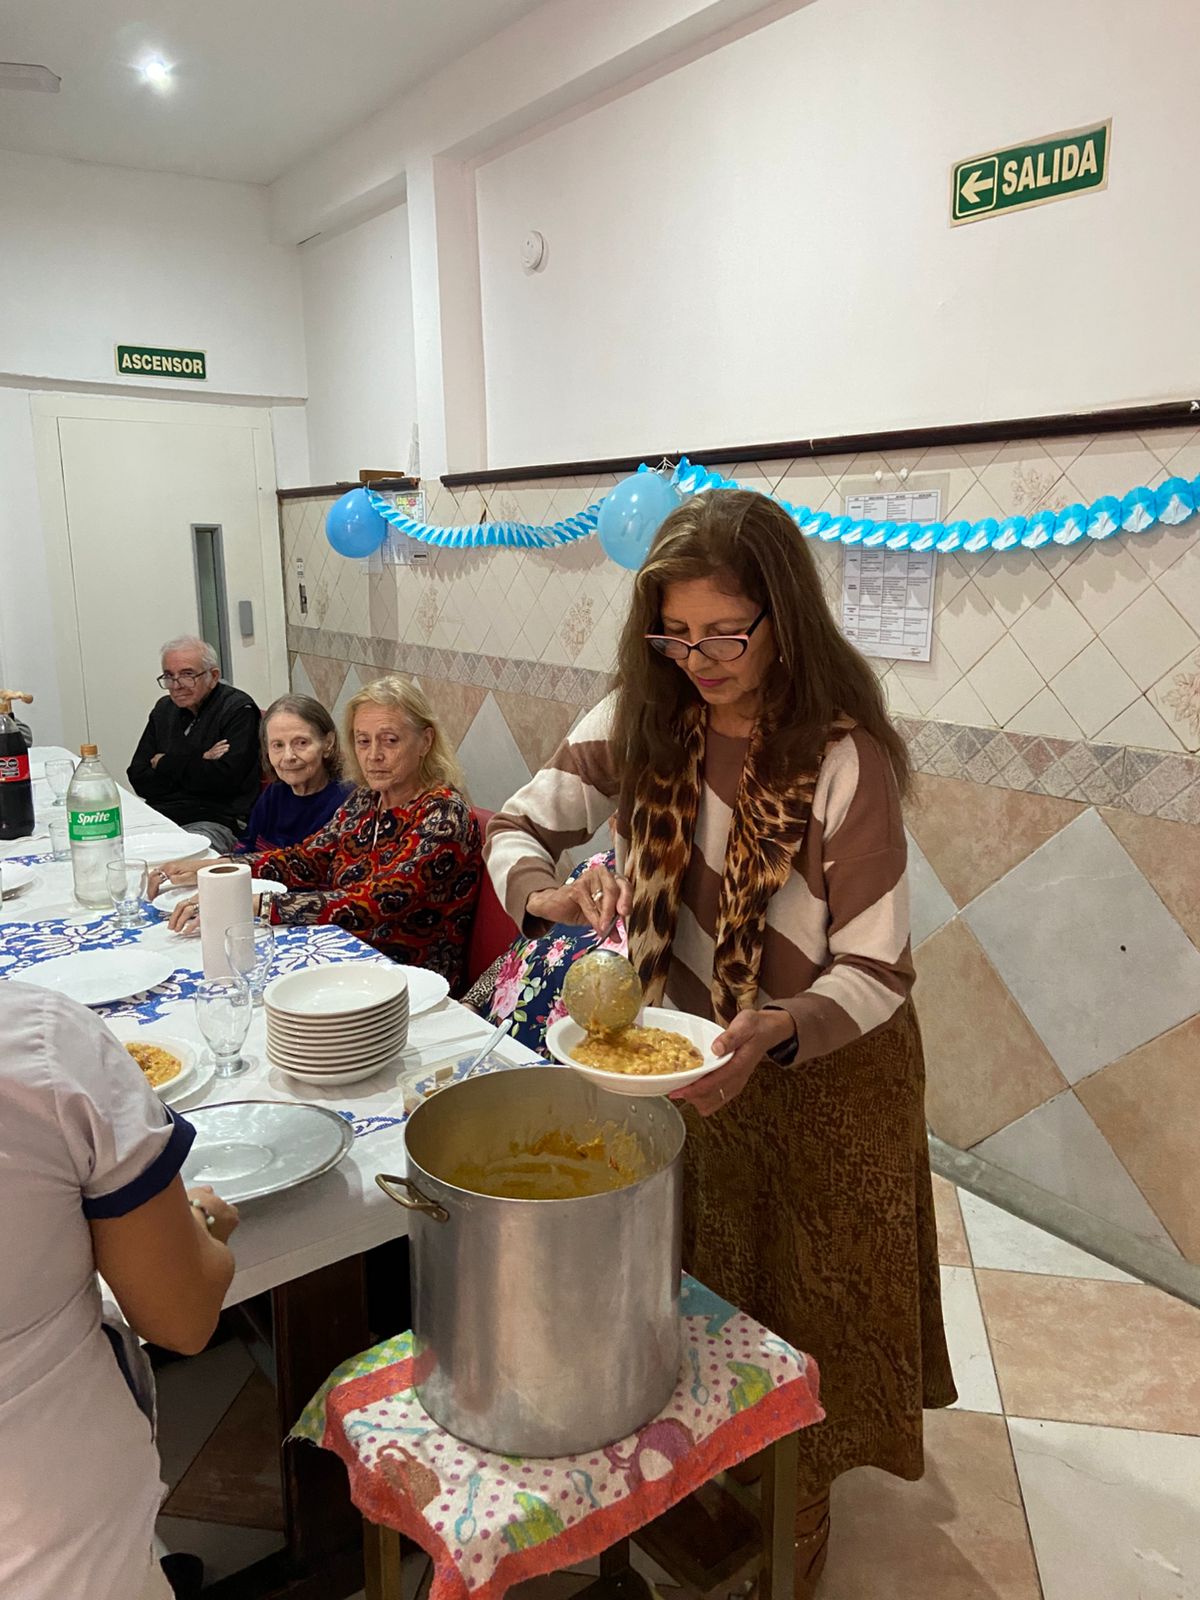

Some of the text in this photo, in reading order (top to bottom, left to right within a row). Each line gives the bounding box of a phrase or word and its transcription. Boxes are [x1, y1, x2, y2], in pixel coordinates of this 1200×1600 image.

[1002, 139, 1097, 196] SALIDA
[122, 353, 204, 374] ASCENSOR
[77, 812, 110, 825] Sprite
